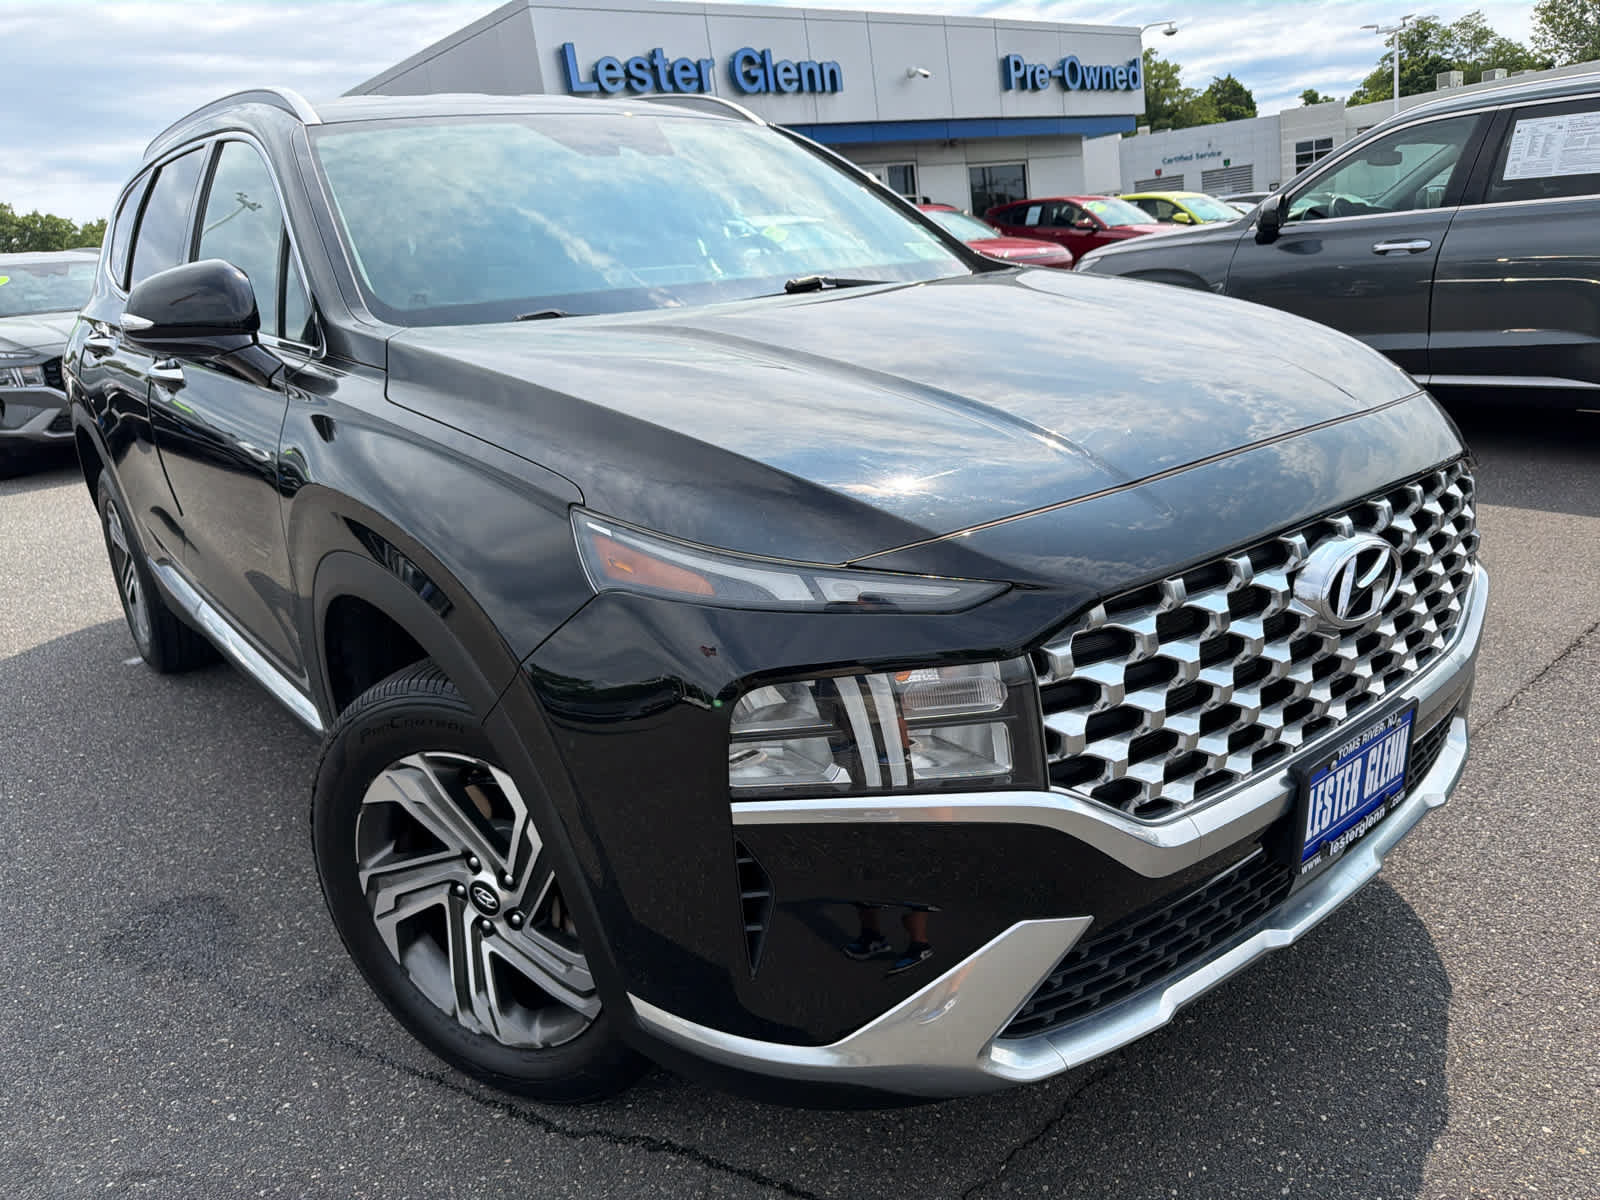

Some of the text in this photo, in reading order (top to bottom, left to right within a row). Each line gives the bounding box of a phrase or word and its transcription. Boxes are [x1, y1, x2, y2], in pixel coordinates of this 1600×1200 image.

[560, 42, 843, 94] Lester Glenn
[1003, 53, 1141, 91] Pre-Owned
[1162, 150, 1222, 165] Certified Service
[1338, 738, 1361, 760] TOMS
[1305, 725, 1410, 842] LESTER GLENN
[1329, 807, 1386, 856] lesterglenn
